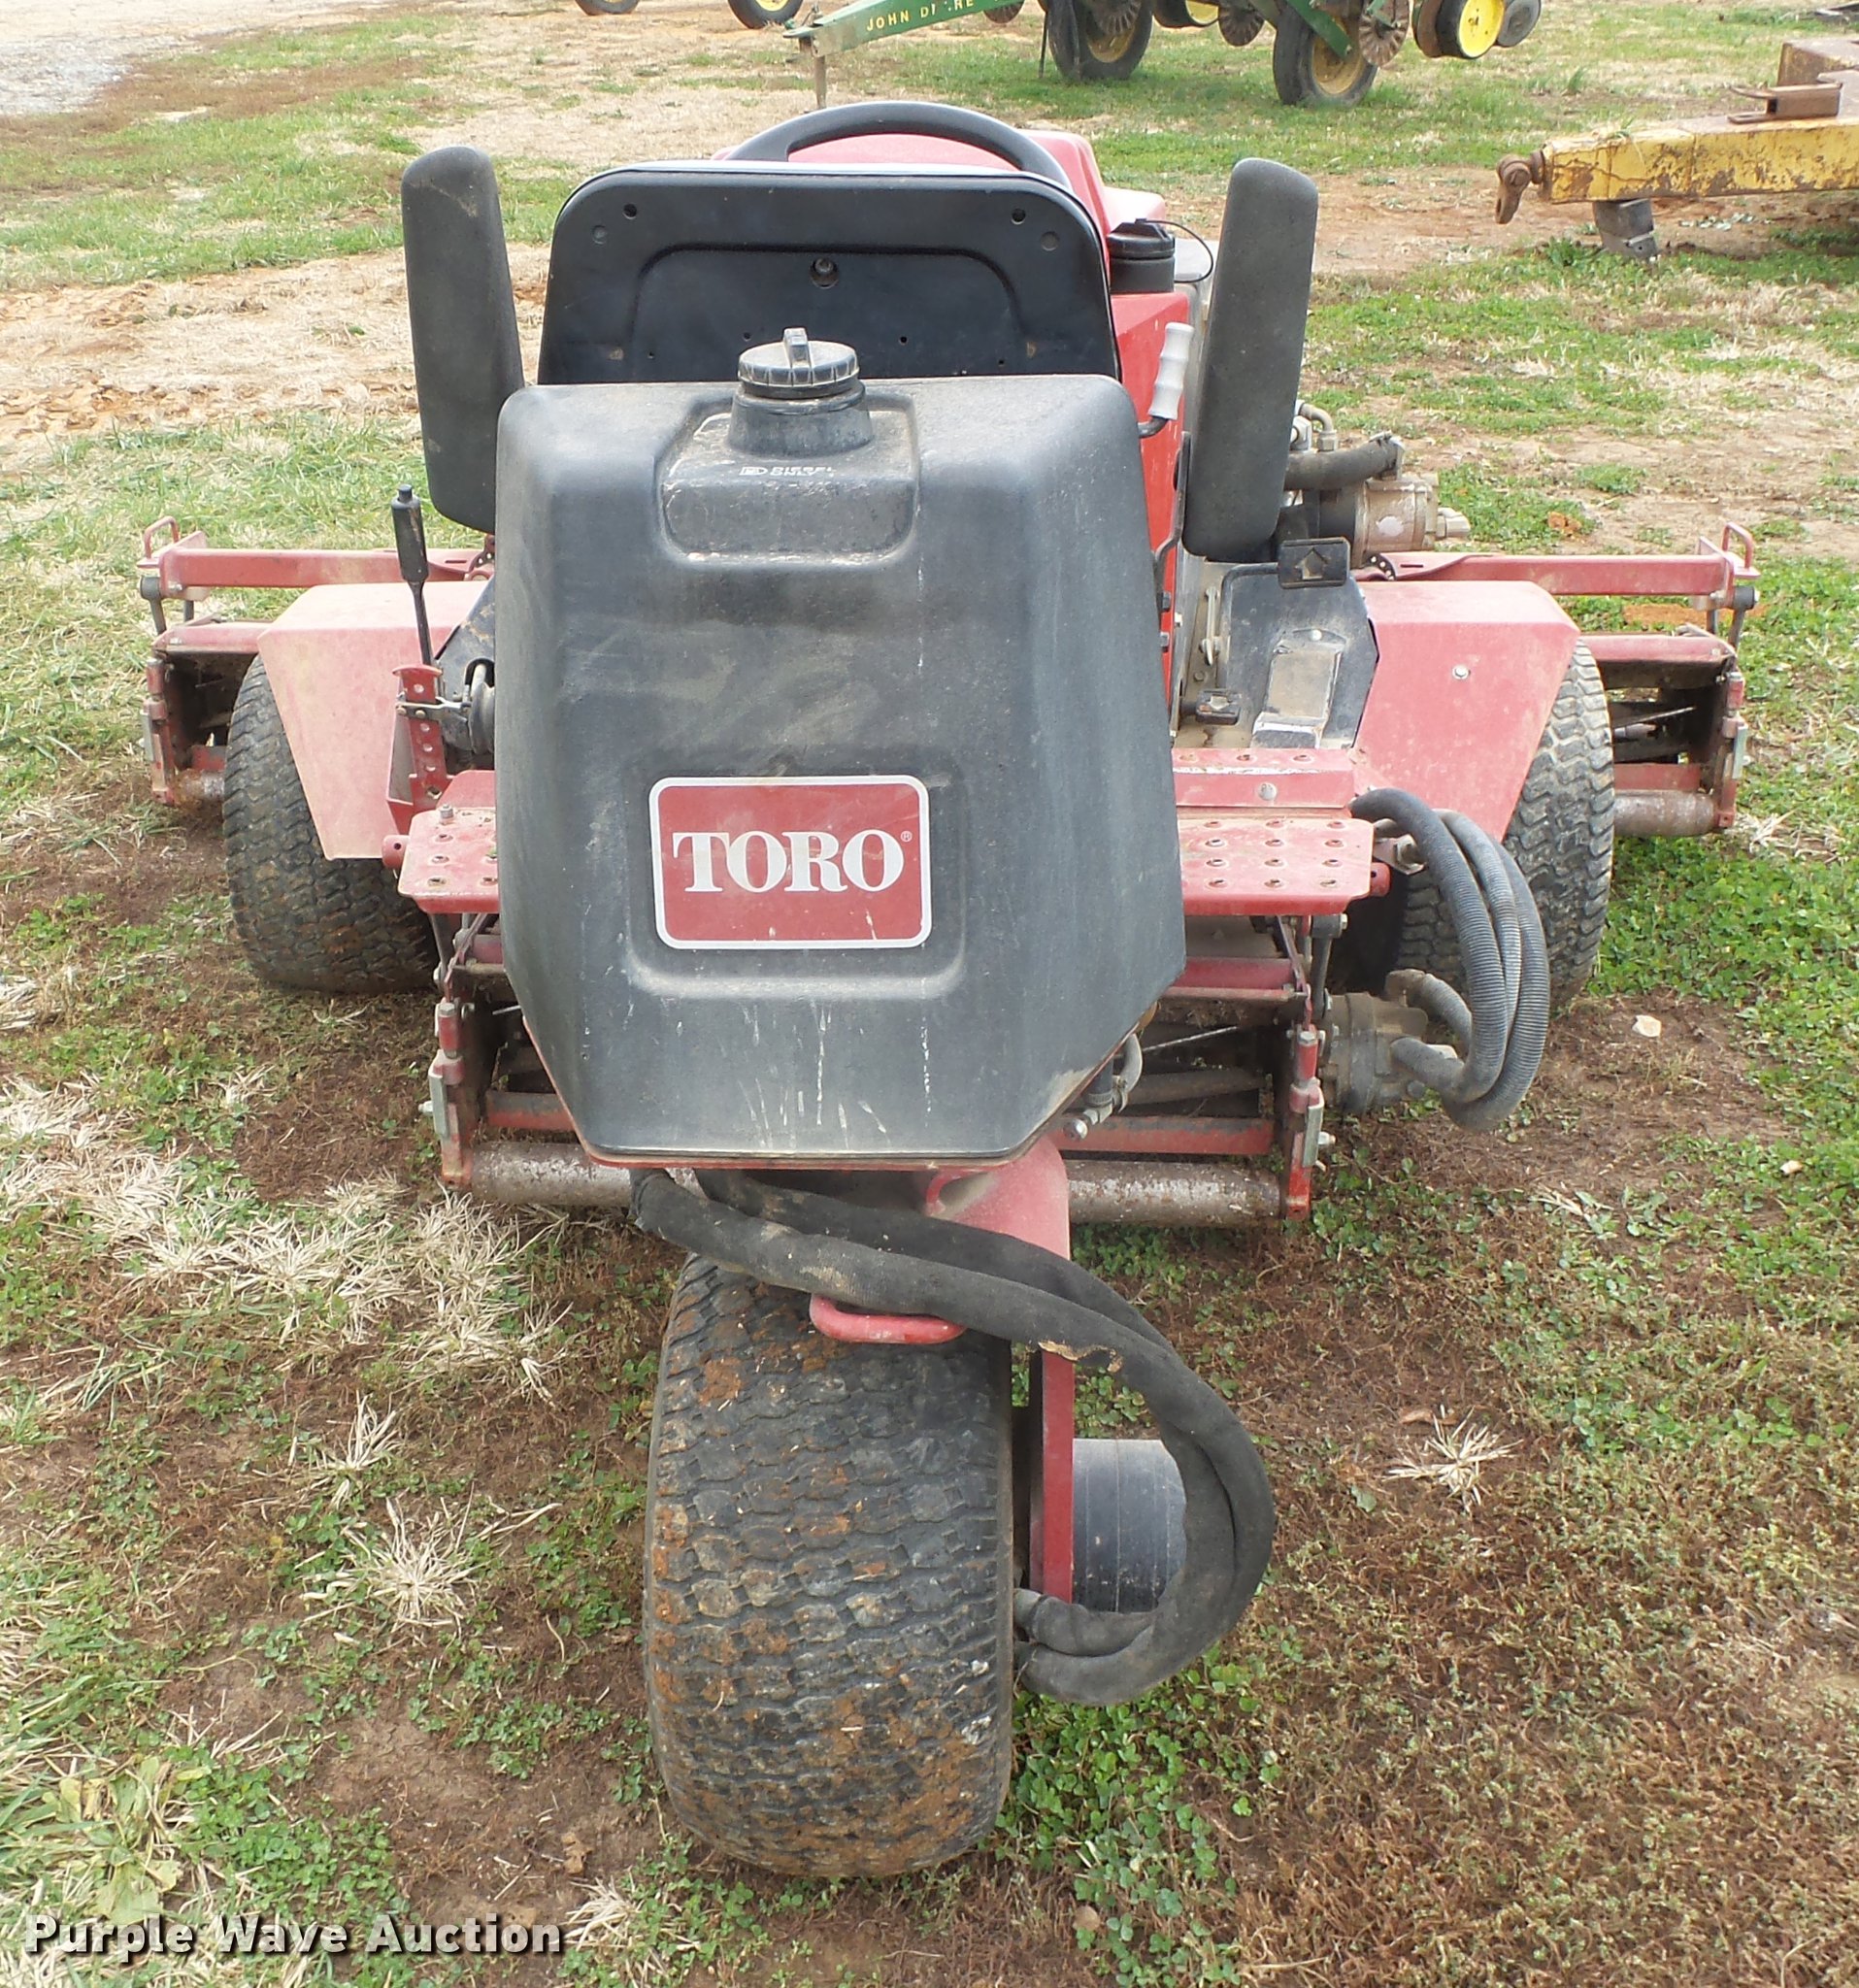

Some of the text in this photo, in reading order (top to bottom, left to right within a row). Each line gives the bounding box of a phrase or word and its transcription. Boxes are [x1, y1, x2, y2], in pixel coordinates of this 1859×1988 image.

[867, 0, 974, 31] JOHN DRE
[672, 830, 905, 892] TORO
